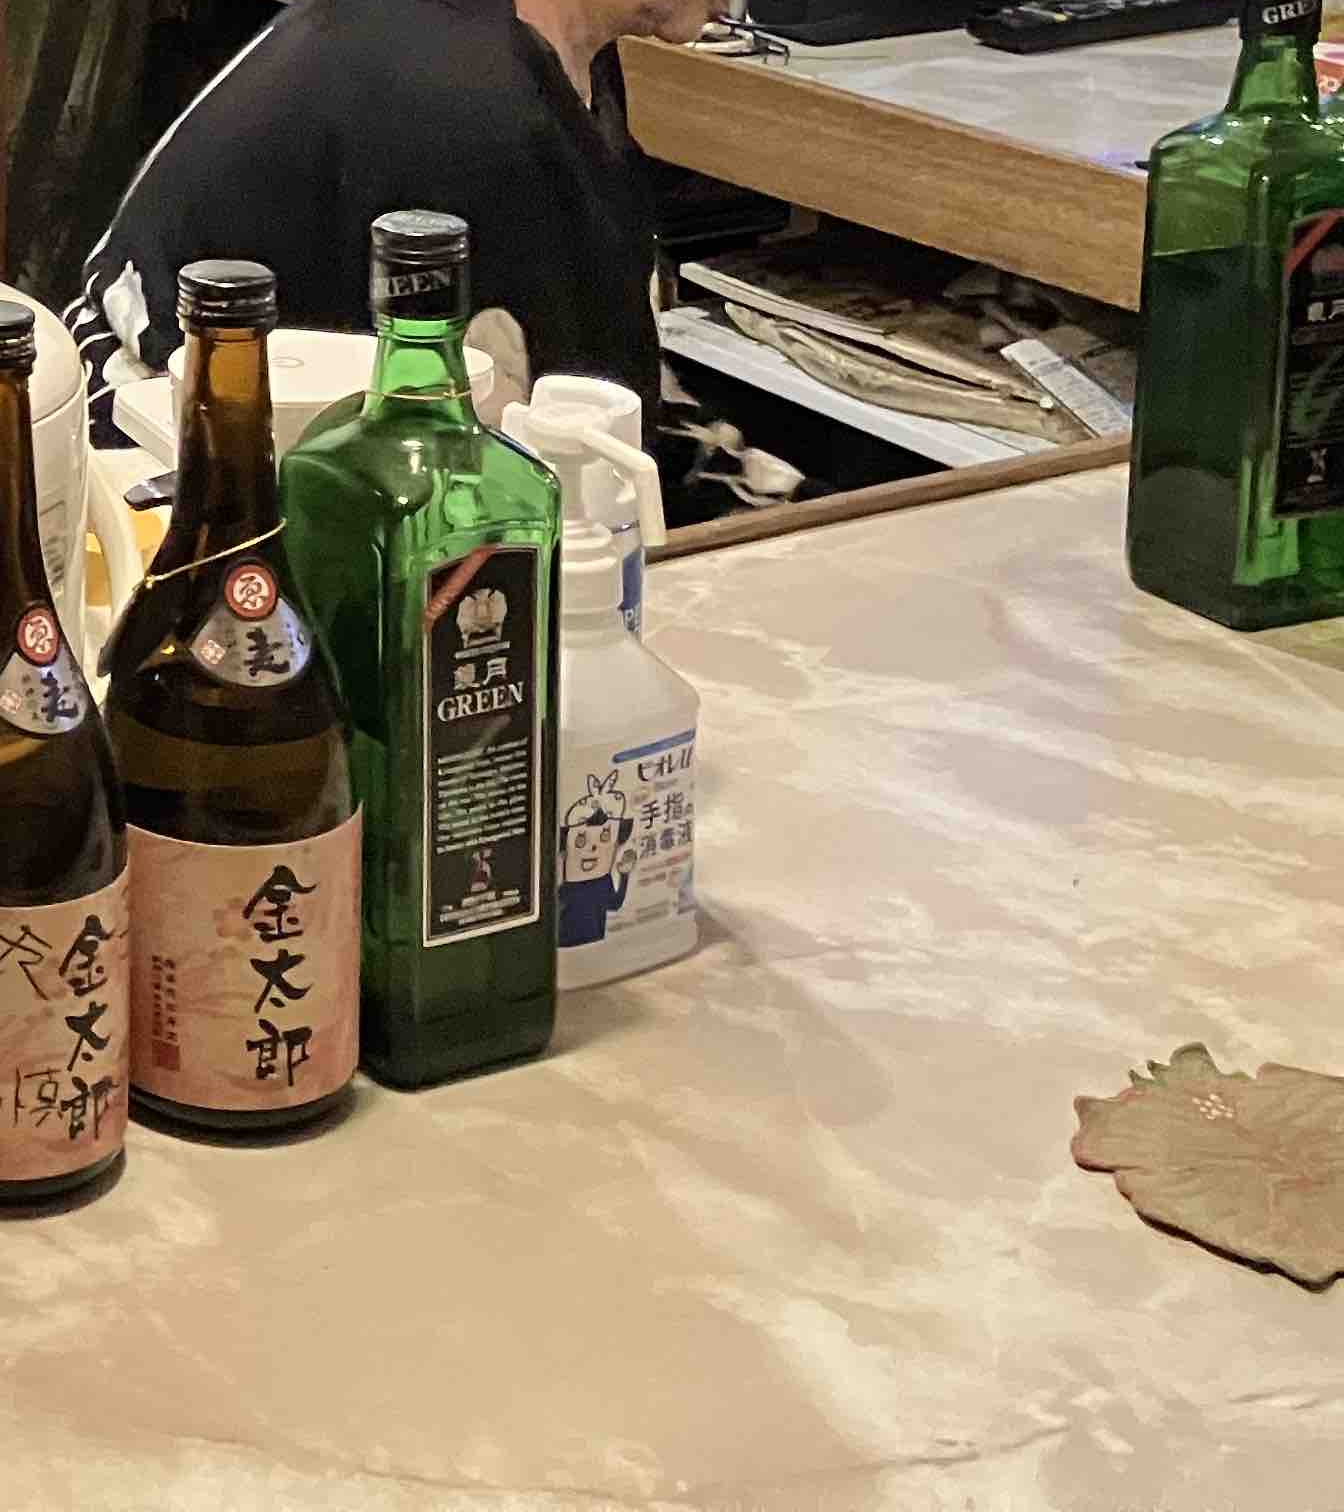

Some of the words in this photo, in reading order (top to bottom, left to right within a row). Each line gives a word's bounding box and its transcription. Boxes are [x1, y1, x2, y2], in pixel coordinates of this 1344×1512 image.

[437, 681, 524, 722] GREEN
[58, 914, 120, 1140] 金太郎
[243, 865, 317, 1088] 金太郎
